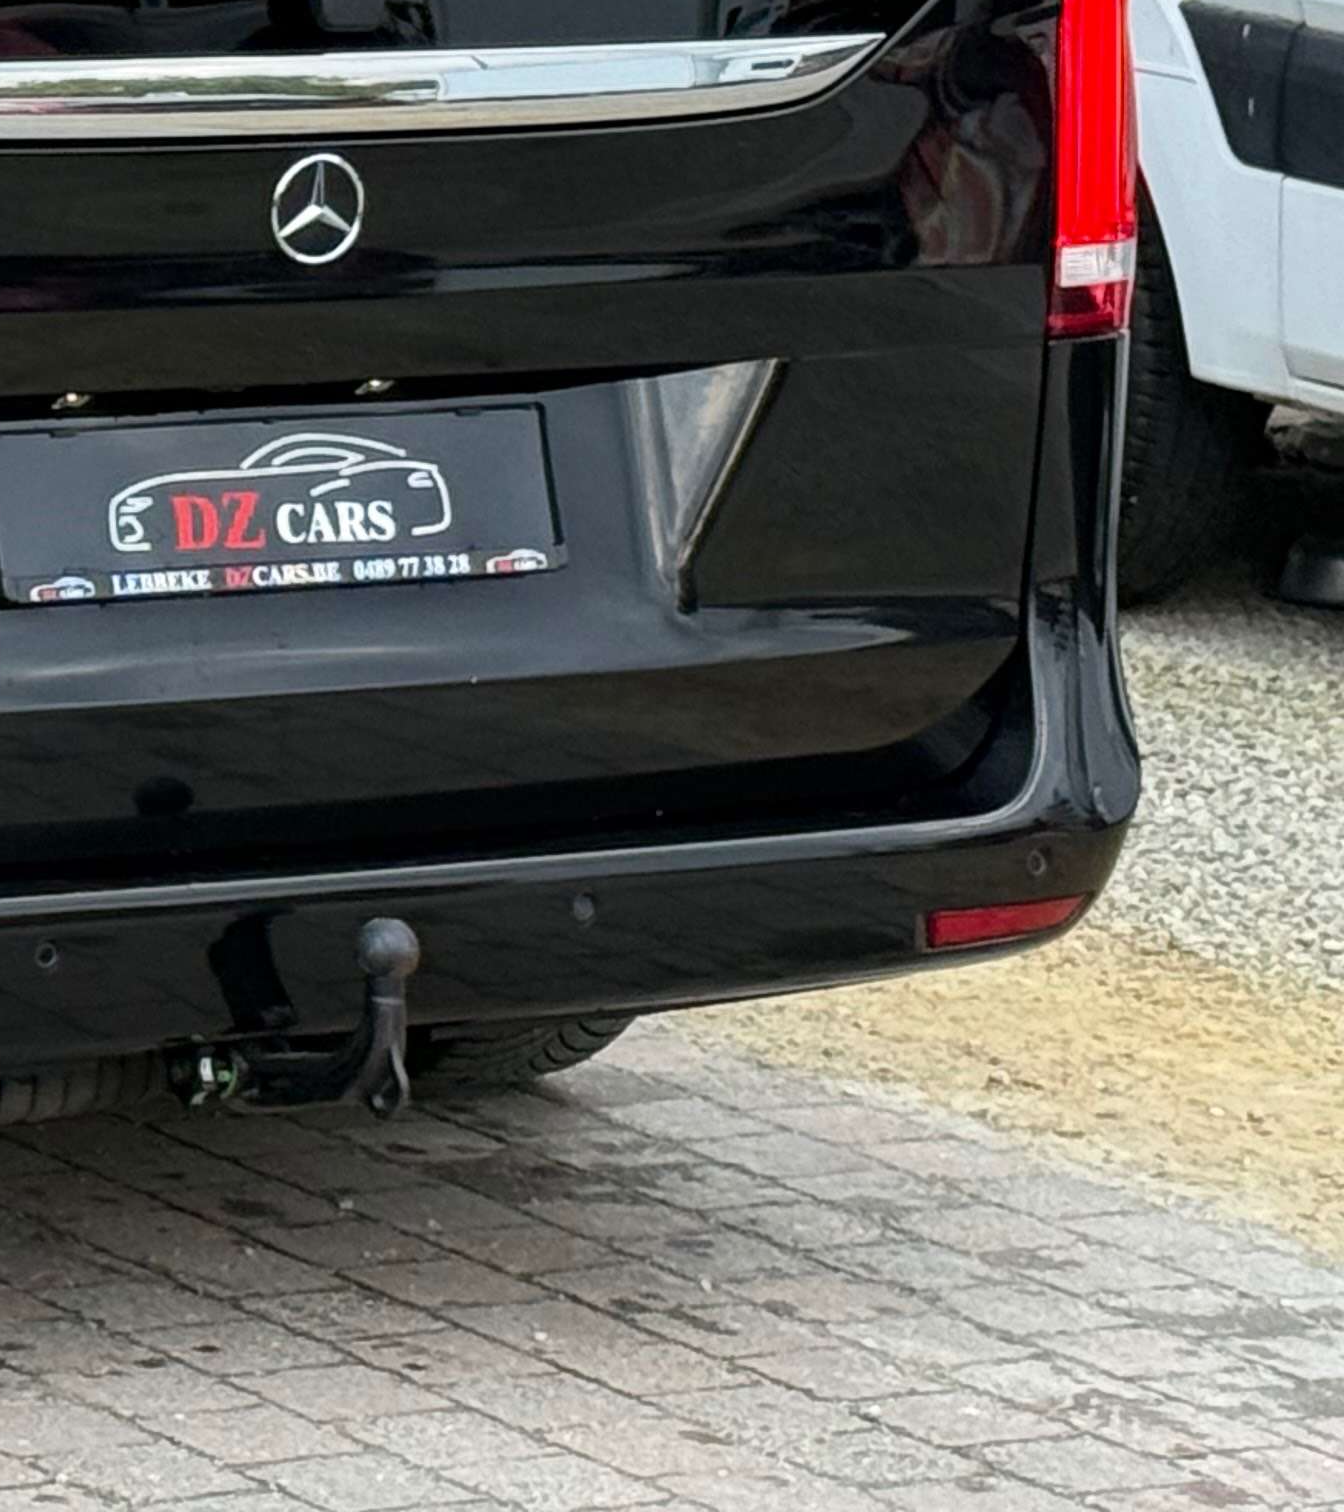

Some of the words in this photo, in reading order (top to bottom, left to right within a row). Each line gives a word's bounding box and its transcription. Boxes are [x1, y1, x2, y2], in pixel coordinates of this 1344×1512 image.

[171, 490, 266, 551] DZ
[276, 500, 396, 544] CARS
[397, 556, 420, 578] 77
